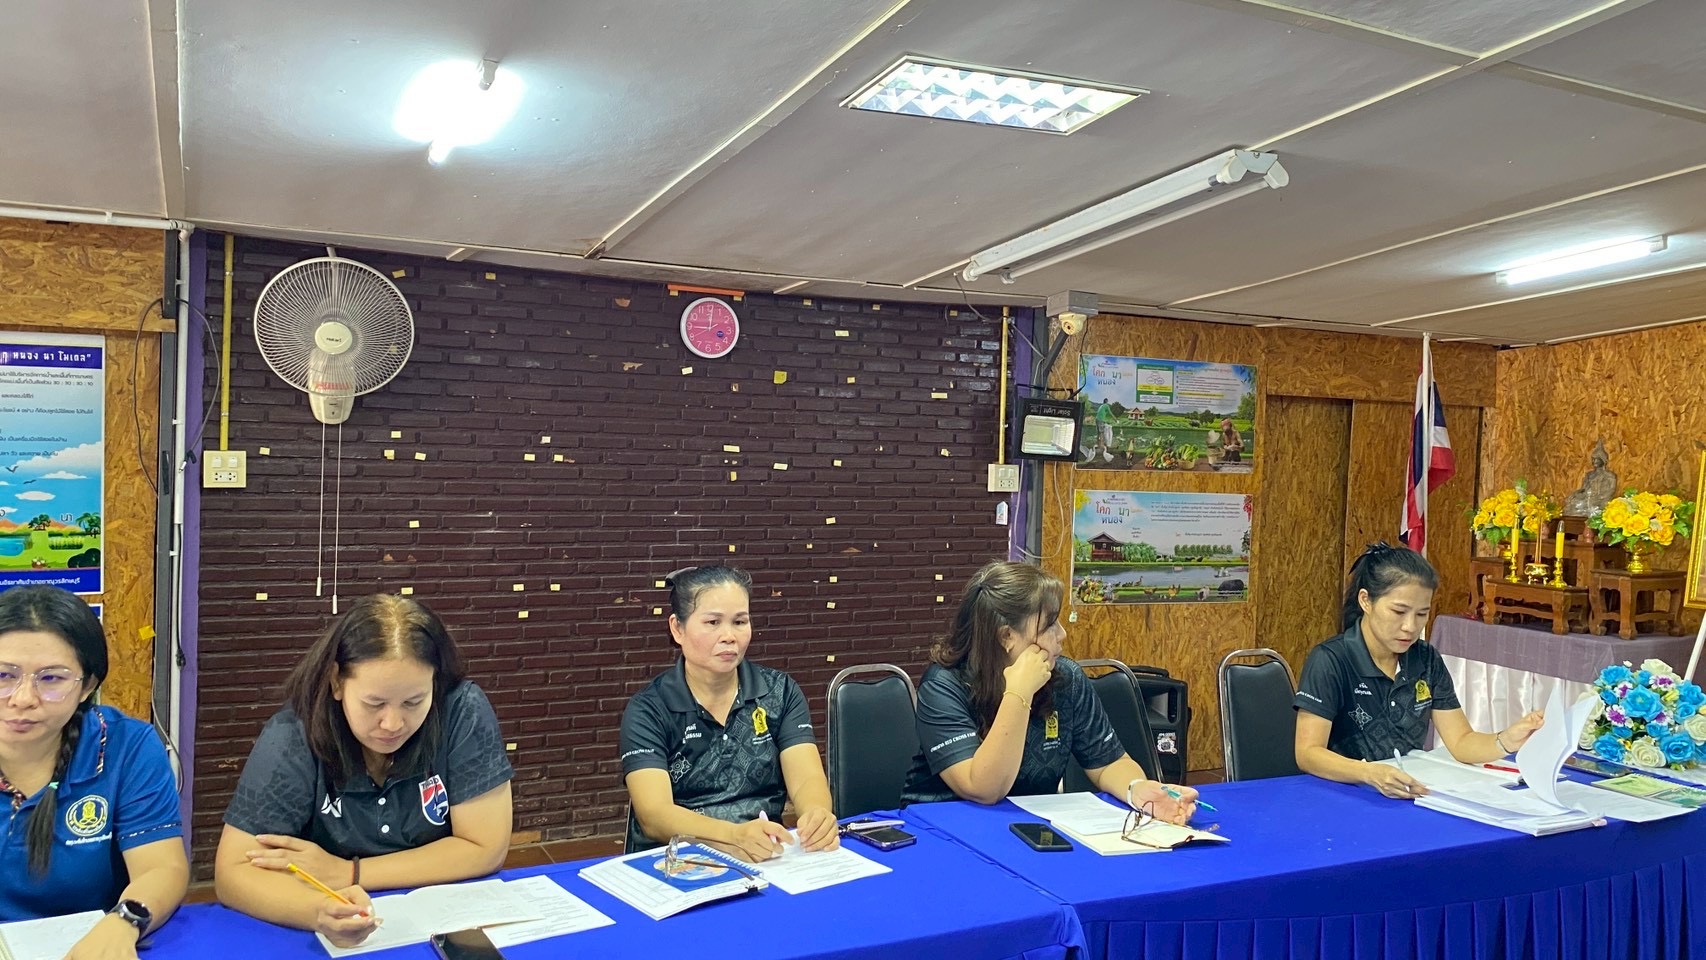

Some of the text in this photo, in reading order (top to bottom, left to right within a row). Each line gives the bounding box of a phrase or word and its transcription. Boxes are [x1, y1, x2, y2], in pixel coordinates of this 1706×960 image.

[13, 351, 39, 360] หนอง
[43, 352, 54, 361] นา
[1057, 408, 1071, 416] Solar
